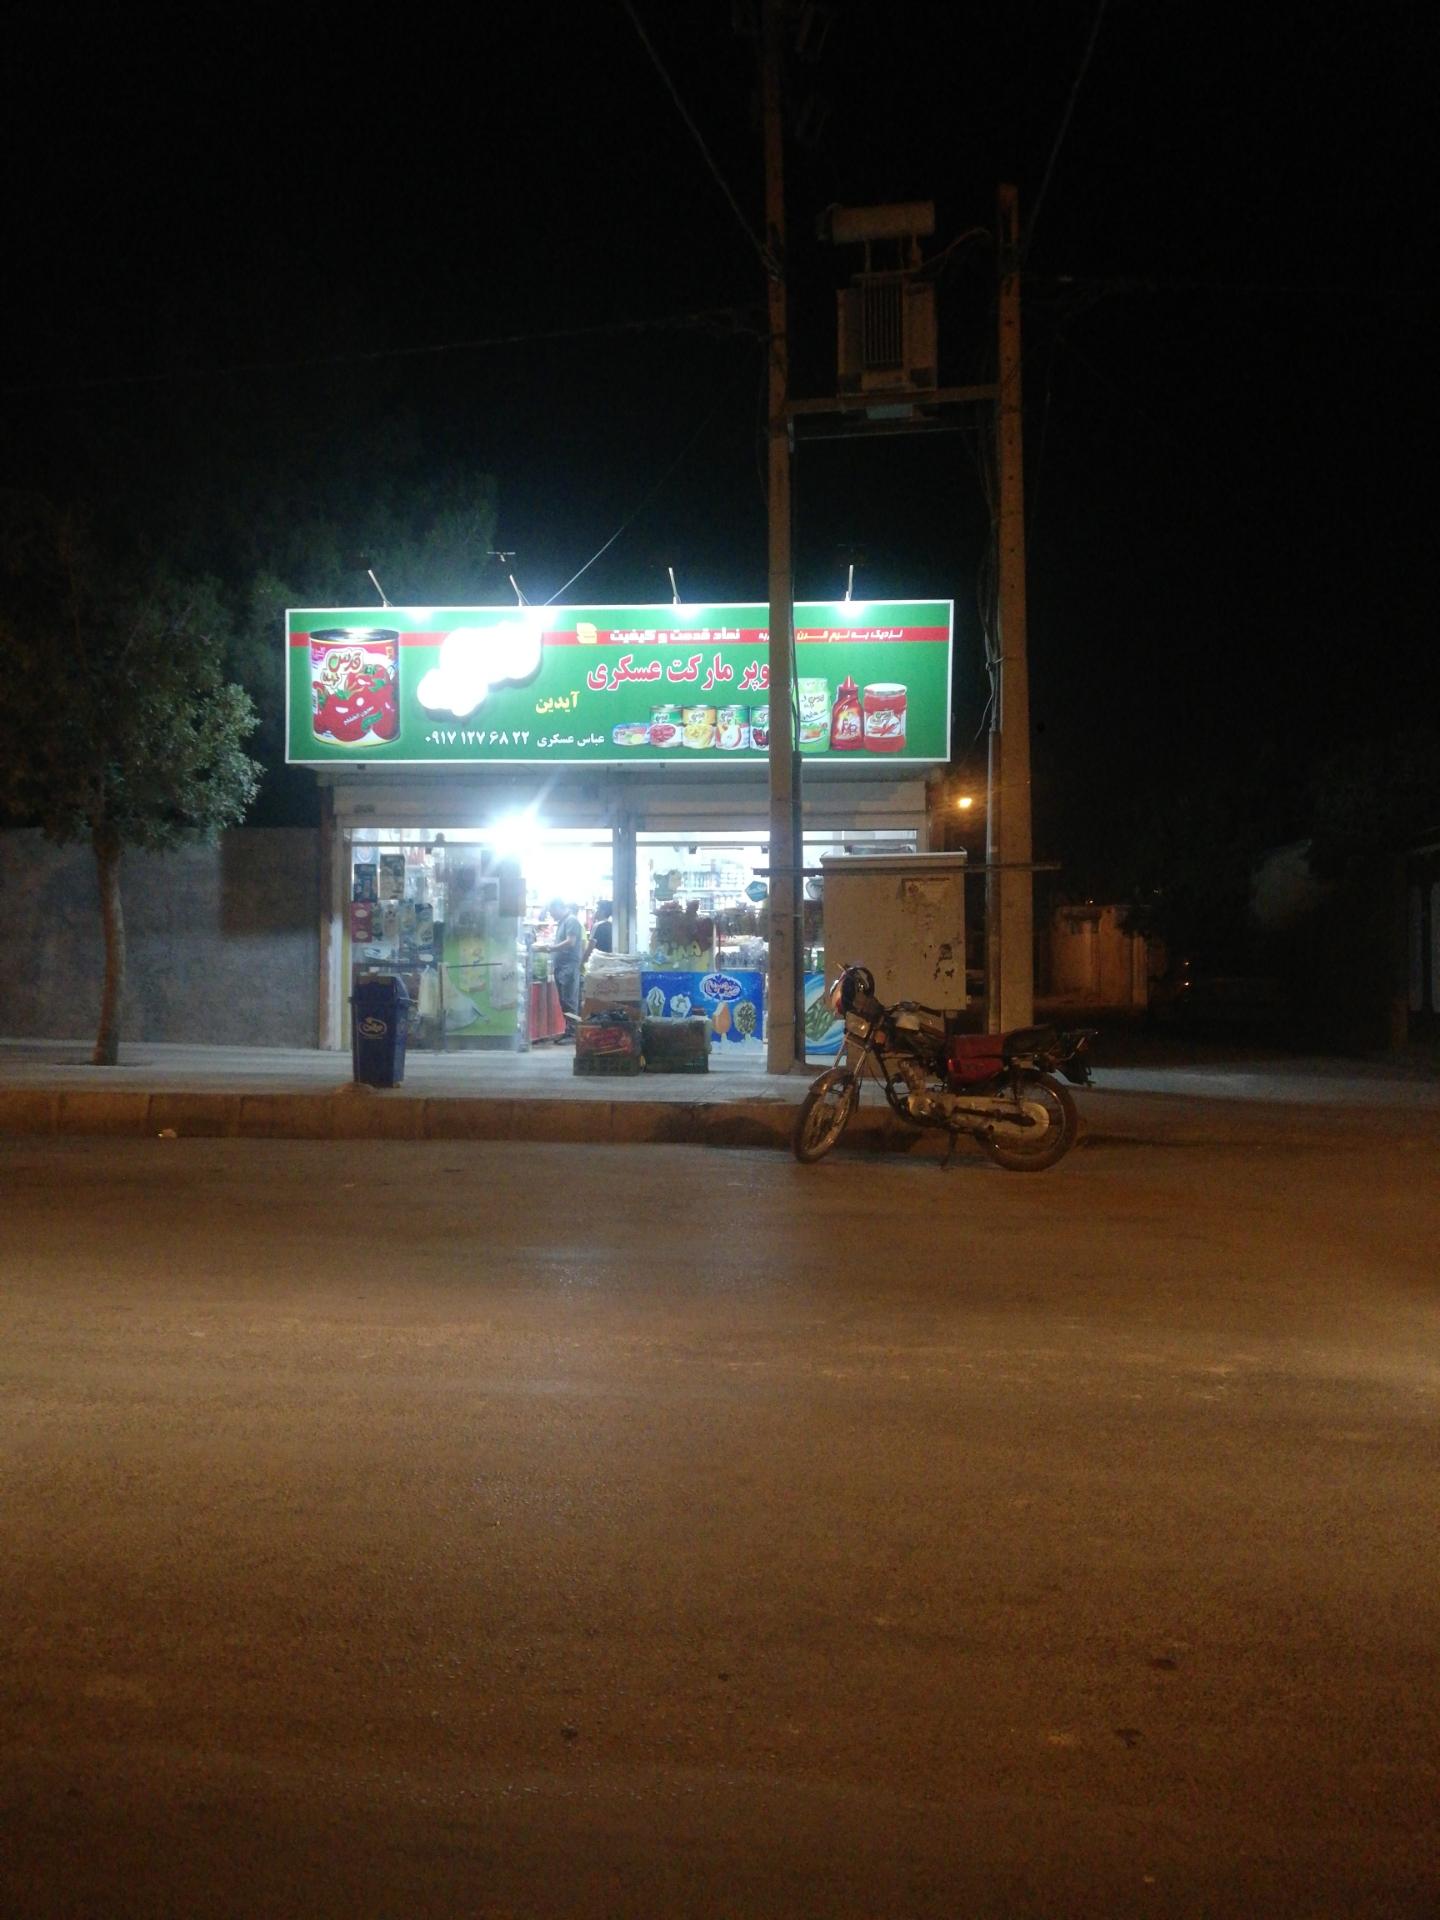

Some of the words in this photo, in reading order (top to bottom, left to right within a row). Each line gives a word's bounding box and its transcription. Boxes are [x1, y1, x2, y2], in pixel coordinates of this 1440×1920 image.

[609, 628, 657, 644] کیفیت
[657, 632, 668, 644] و
[712, 626, 741, 640] نماد
[851, 630, 870, 640] به
[586, 653, 663, 691] عسکری
[666, 652, 734, 691] مارکت
[738, 659, 770, 691] وپر
[535, 690, 581, 714] آیدین
[536, 733, 575, 748] عسکری
[577, 733, 605, 747] عباس
